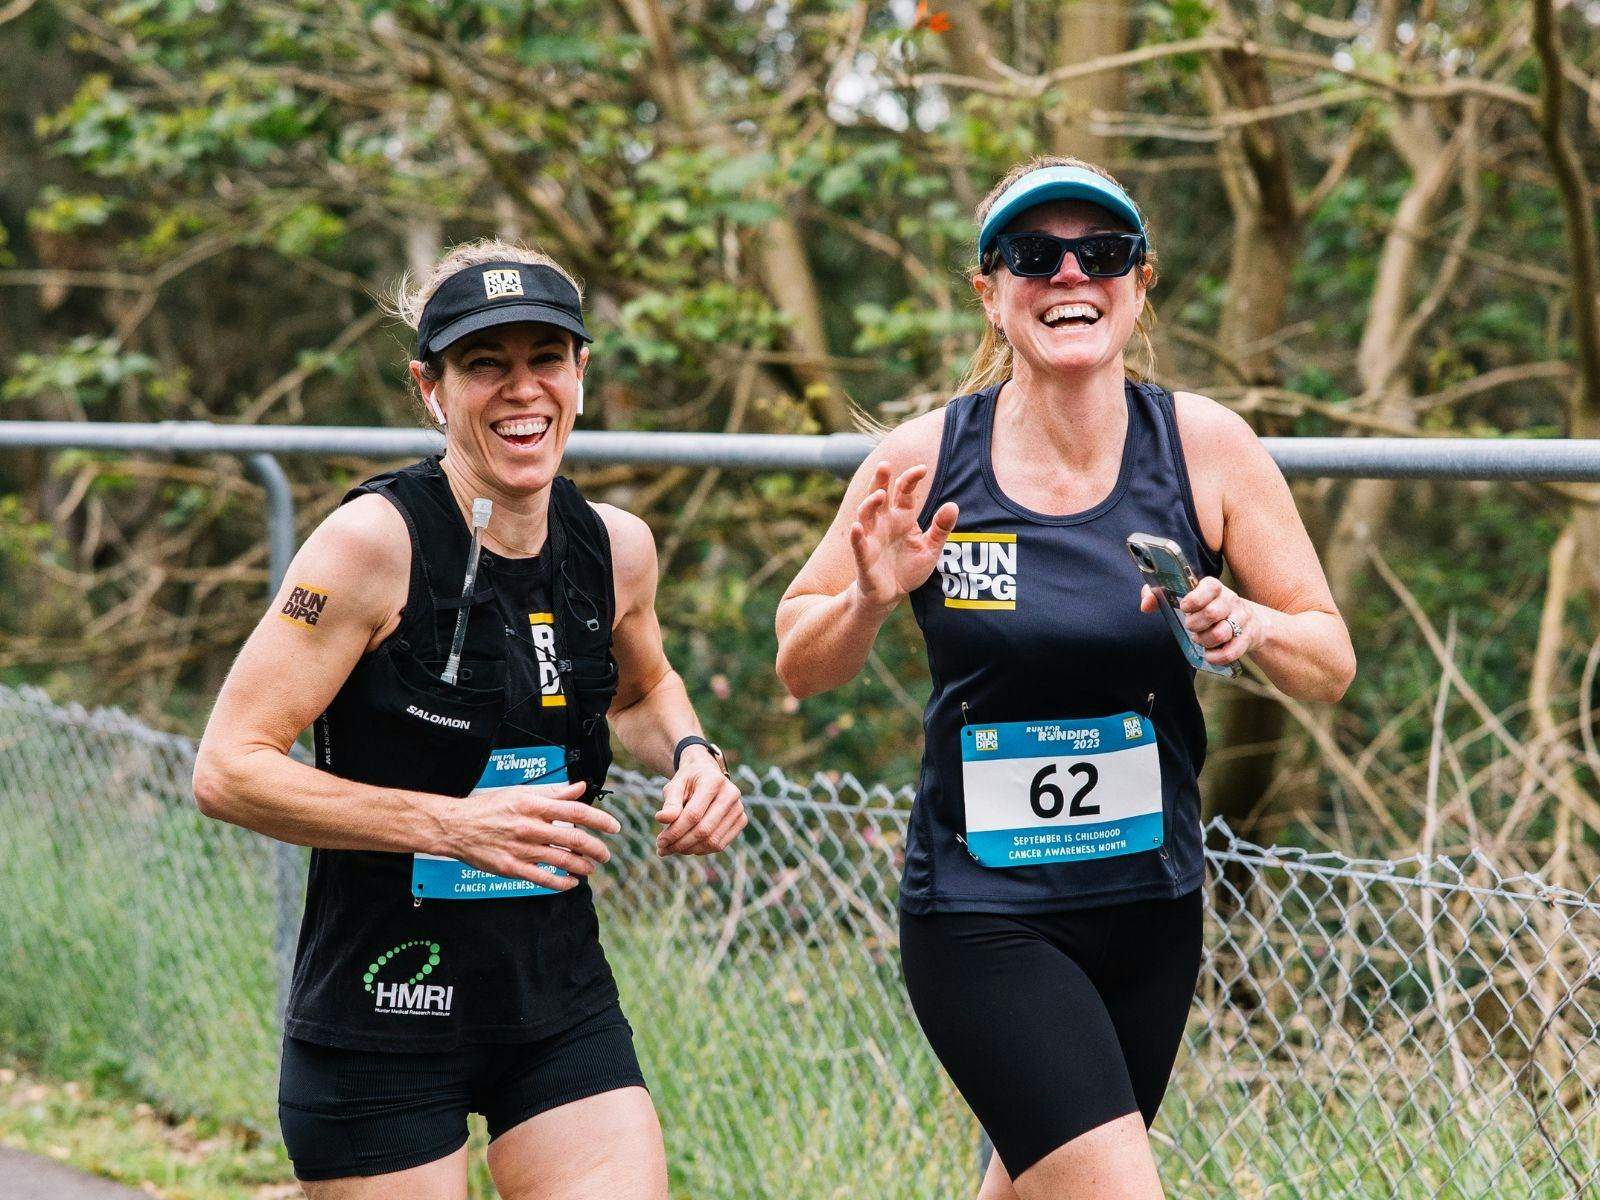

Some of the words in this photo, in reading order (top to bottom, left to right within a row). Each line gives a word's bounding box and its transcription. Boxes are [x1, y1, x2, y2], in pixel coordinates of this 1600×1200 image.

[483, 271, 522, 286] RUN
[485, 283, 524, 297] DIPG
[937, 542, 1017, 574] RUN
[941, 573, 1017, 600] DIPG
[289, 586, 328, 613] RUN
[281, 601, 320, 625] DIPG
[406, 705, 471, 730] SALOMON
[1124, 718, 1140, 730] RUN
[976, 731, 998, 741] RUN
[1038, 728, 1100, 742] RUNDIPG
[1125, 727, 1142, 738] DIPG
[976, 740, 998, 749] DIPG
[1073, 739, 1100, 750] 2023
[496, 757, 547, 771] RUNDIPG
[523, 767, 547, 779] 2023
[1030, 762, 1100, 819] 62
[1013, 834, 1061, 846] SEPTEMBER
[1064, 834, 1072, 842] IS
[1075, 828, 1121, 841] CHILDHOOD
[1008, 849, 1042, 860] CANCER
[1045, 845, 1095, 857] AWARENESS
[1098, 840, 1127, 852] MONTH
[454, 883, 486, 893] CANCER
[489, 881, 535, 892] AWARENESS
[376, 982, 454, 1011] HMRI
